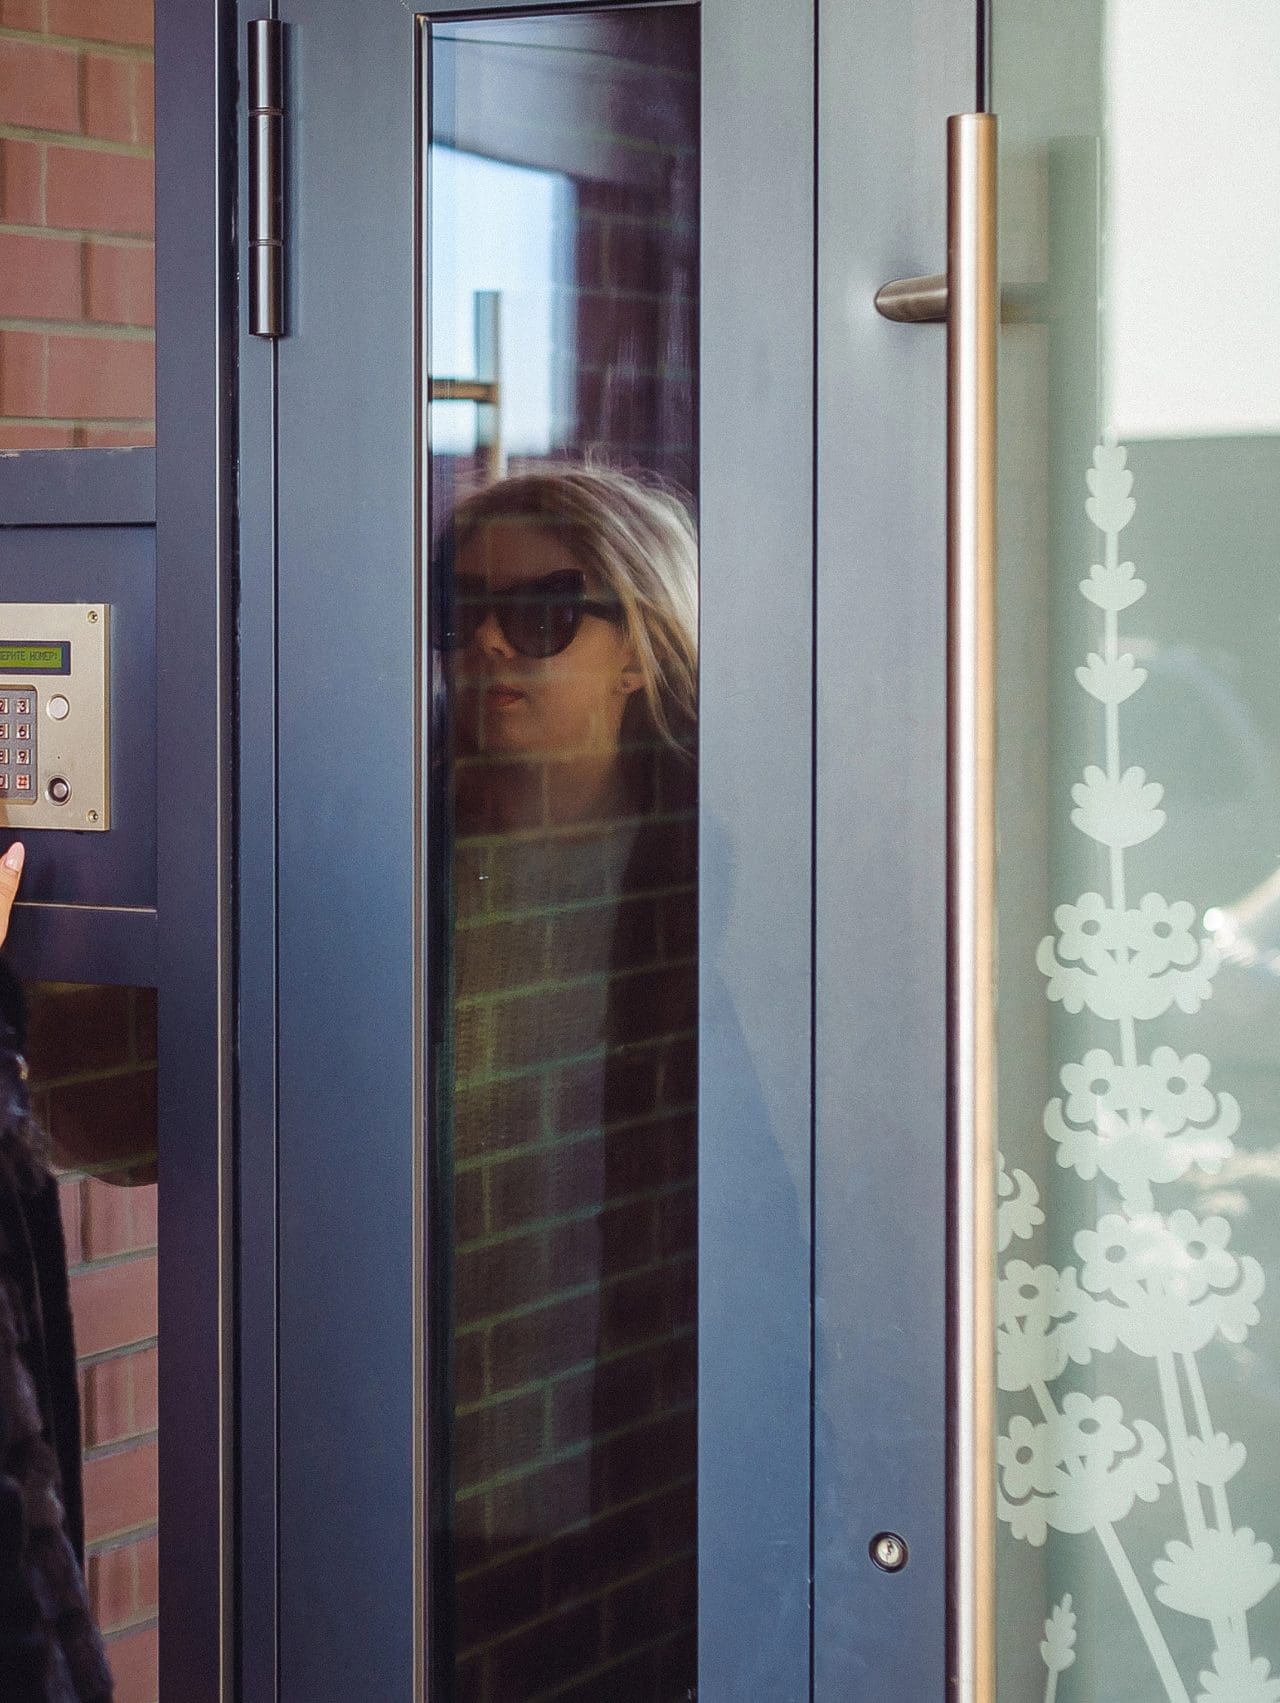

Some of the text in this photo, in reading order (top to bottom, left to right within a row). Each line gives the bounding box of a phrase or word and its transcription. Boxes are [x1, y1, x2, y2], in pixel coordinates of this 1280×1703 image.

[18, 701, 26, 712] 3
[18, 725, 26, 737] 6
[18, 751, 26, 762] 9
